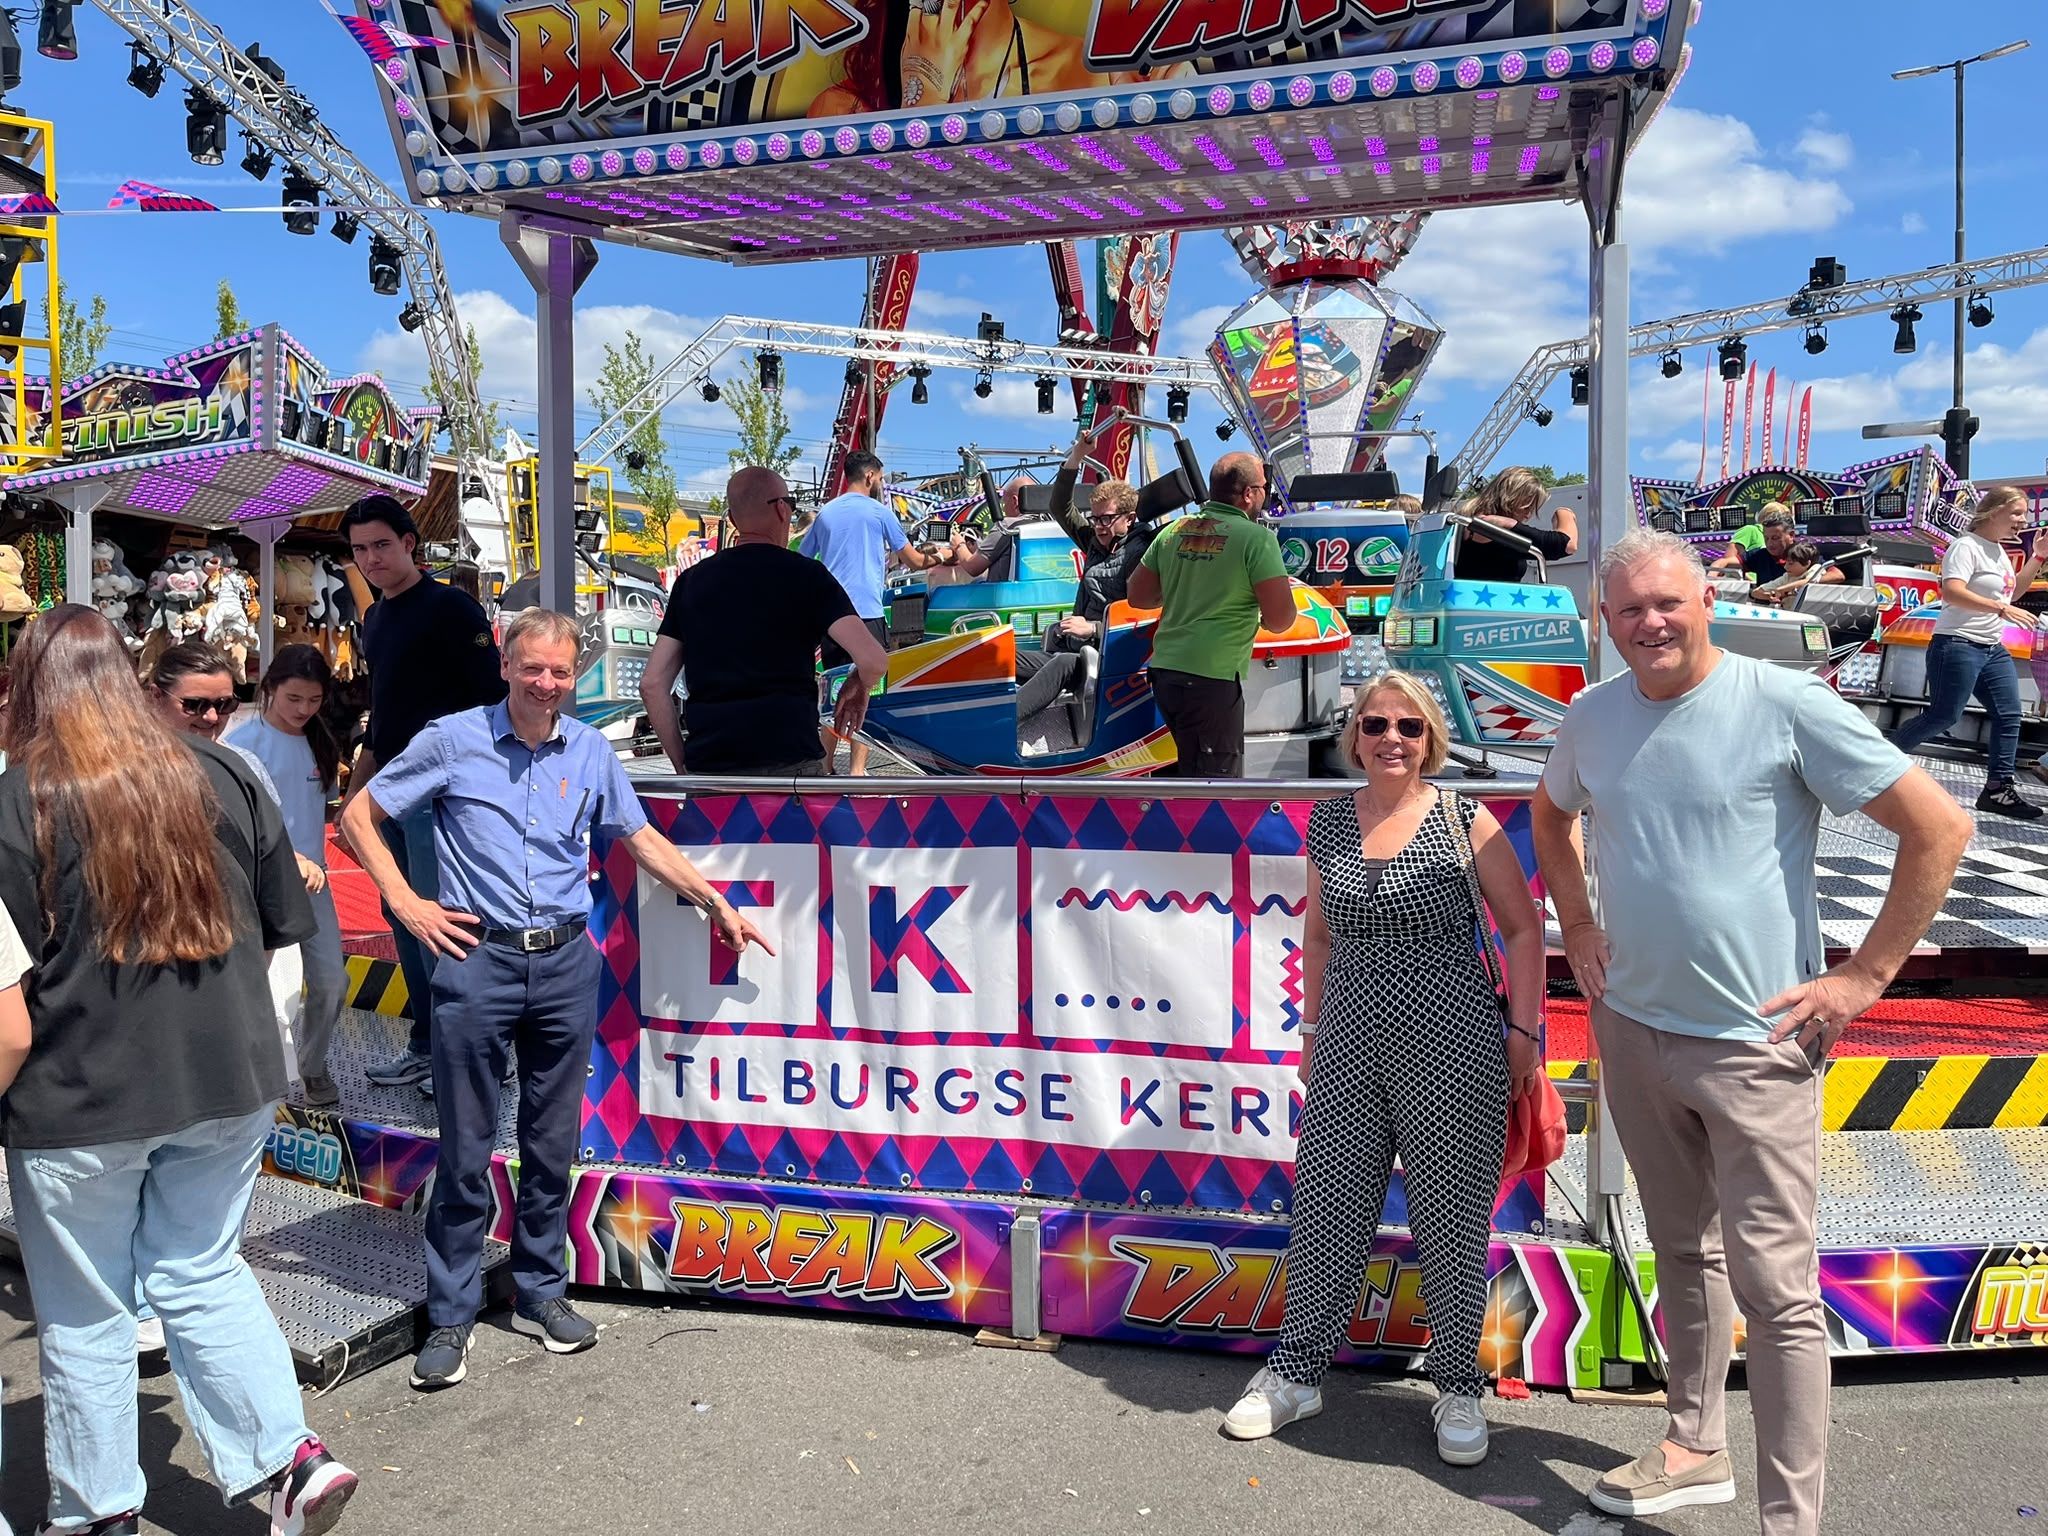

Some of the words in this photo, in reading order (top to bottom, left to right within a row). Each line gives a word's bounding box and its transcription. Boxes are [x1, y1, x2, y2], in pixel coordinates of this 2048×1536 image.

[503, 0, 862, 121] BREAK
[1316, 538, 1350, 573] 12
[1463, 620, 1571, 648] SAFETYCAR
[1900, 586, 1920, 610] 14
[677, 881, 774, 985] T
[869, 885, 973, 993] K
[664, 1053, 1075, 1122] TILBURGSE
[669, 1200, 955, 1297] BREAK
[1115, 1240, 1432, 1347] DACE
